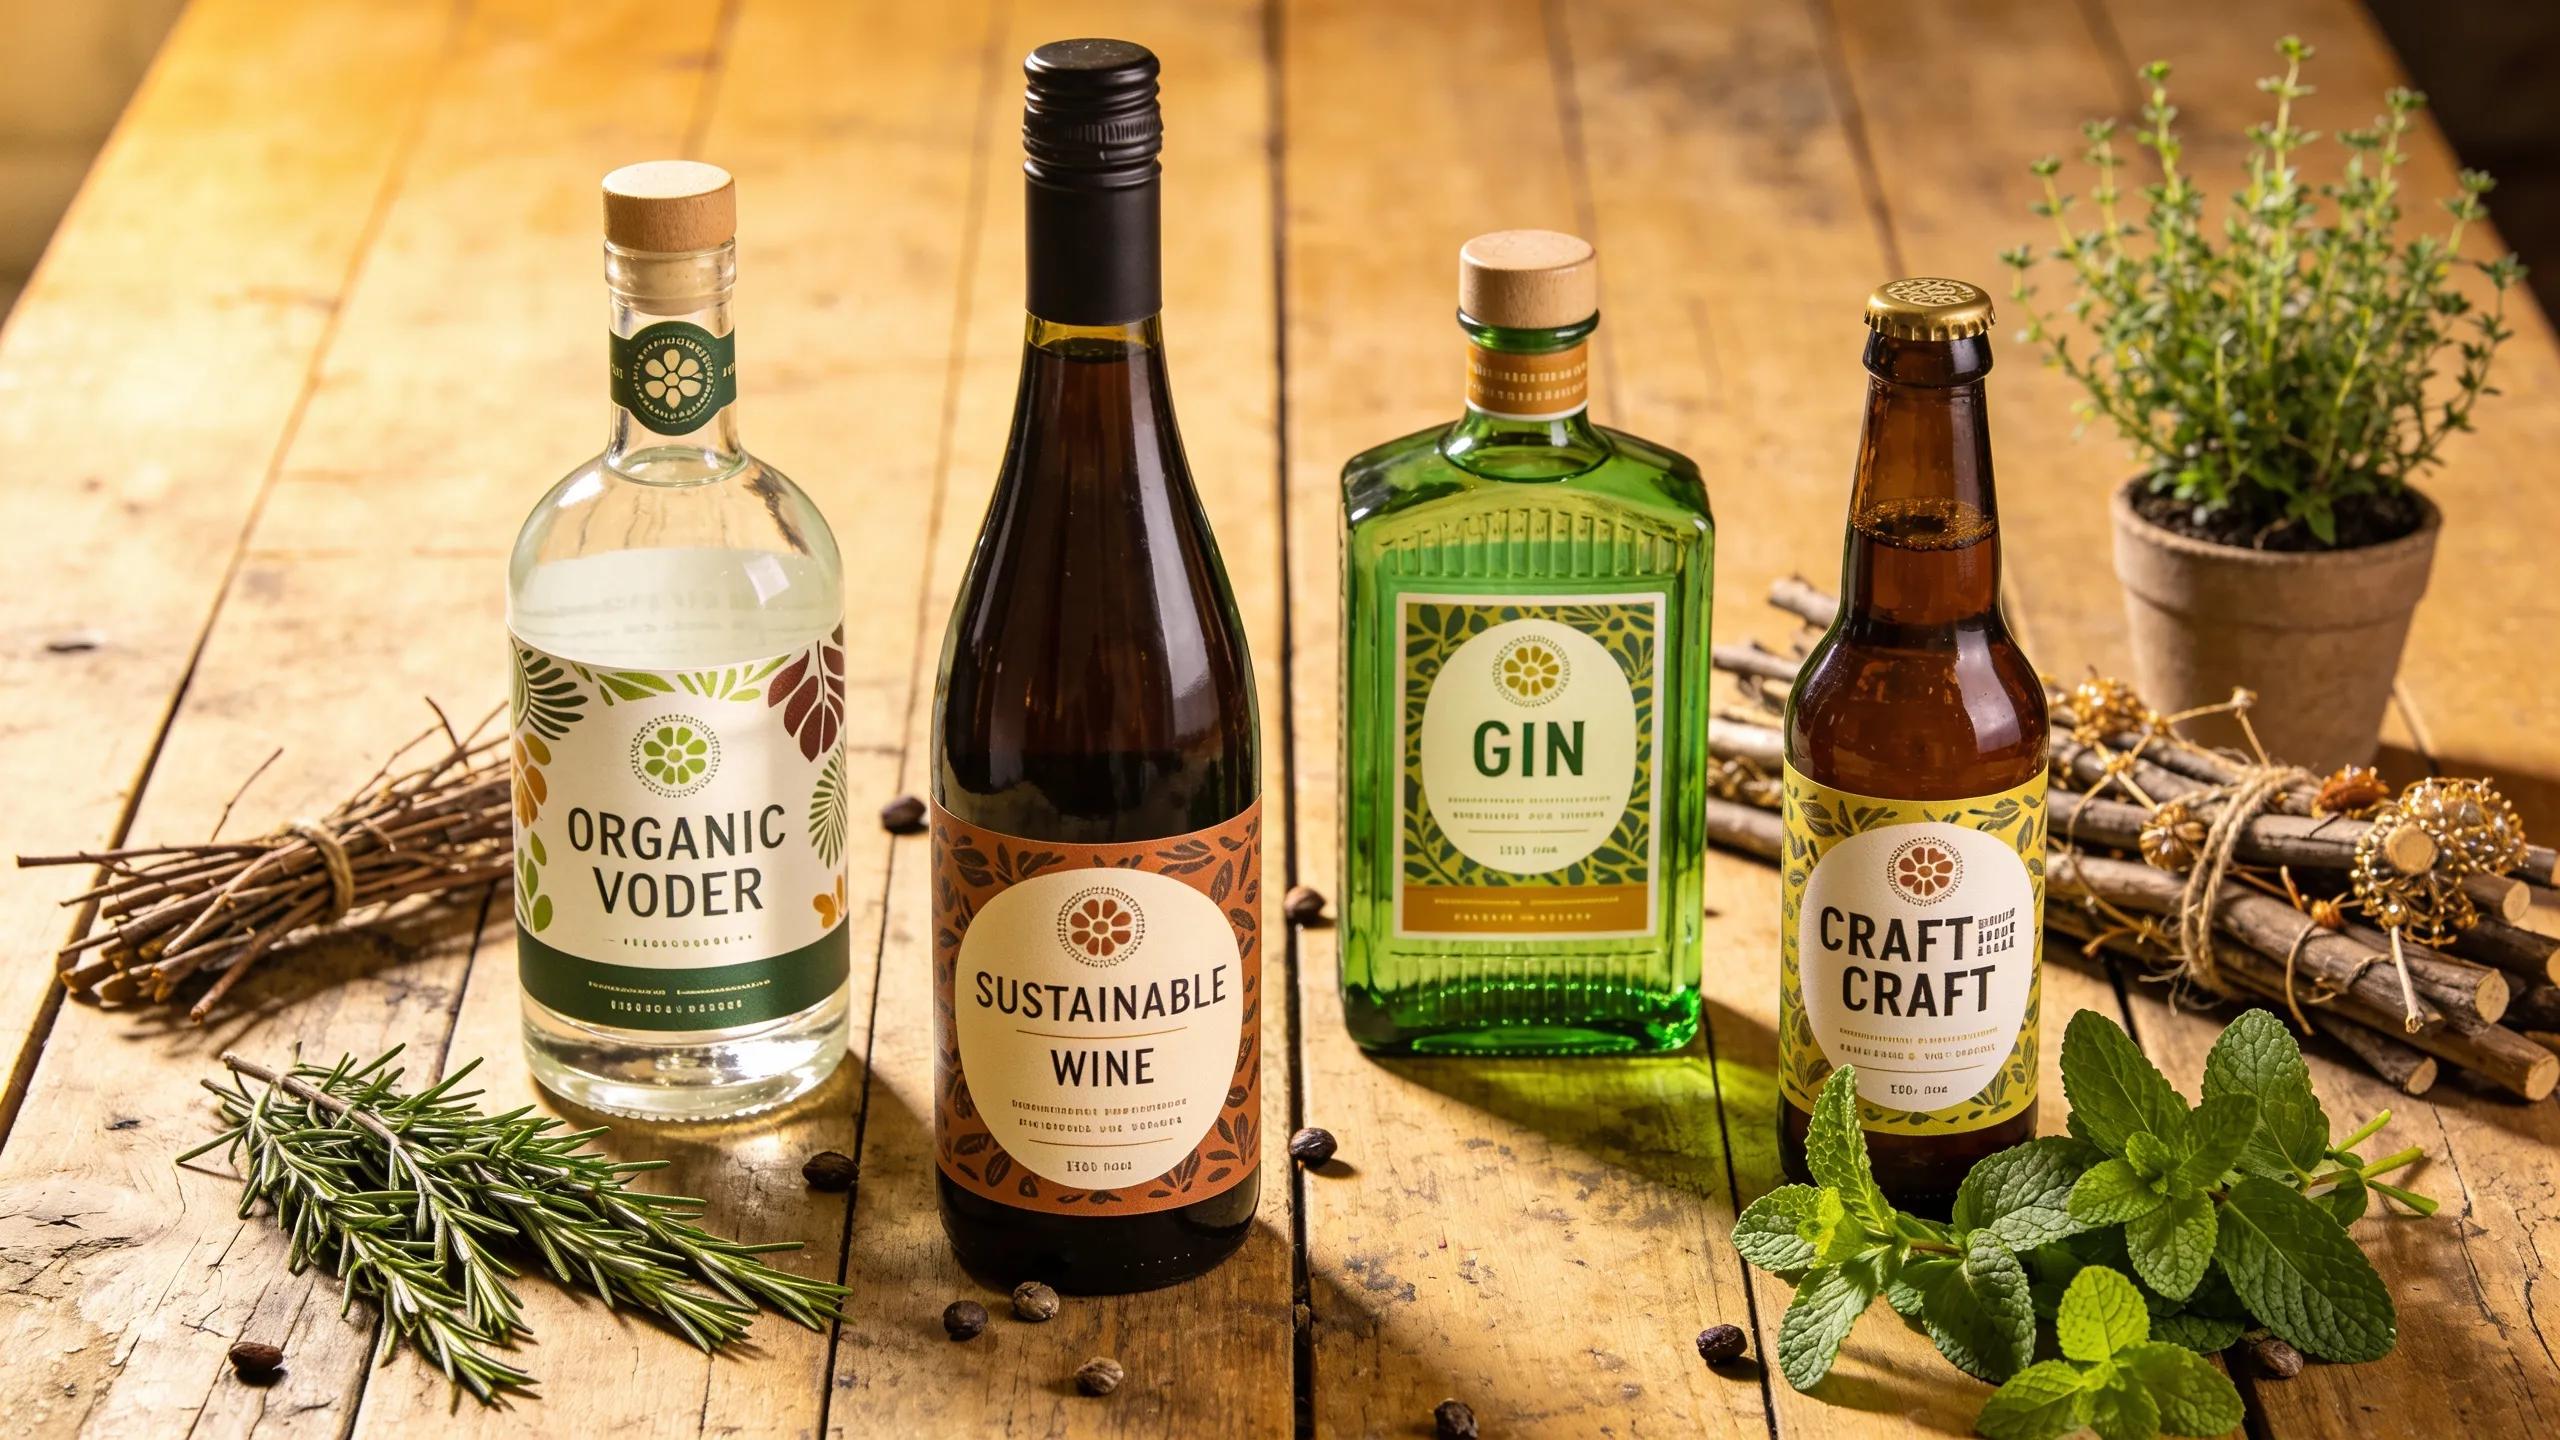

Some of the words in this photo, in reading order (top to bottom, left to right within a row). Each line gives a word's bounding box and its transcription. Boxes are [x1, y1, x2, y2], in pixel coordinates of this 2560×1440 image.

[1473, 720, 1585, 777] GIN
[568, 804, 786, 861] ORGANIC
[592, 867, 763, 918] VODER
[1820, 906, 1973, 962] CRAFT
[975, 964, 1227, 1022] SUSTAINABLE
[1842, 964, 1996, 1018] CRAFT
[1050, 1048, 1155, 1087] WINE
